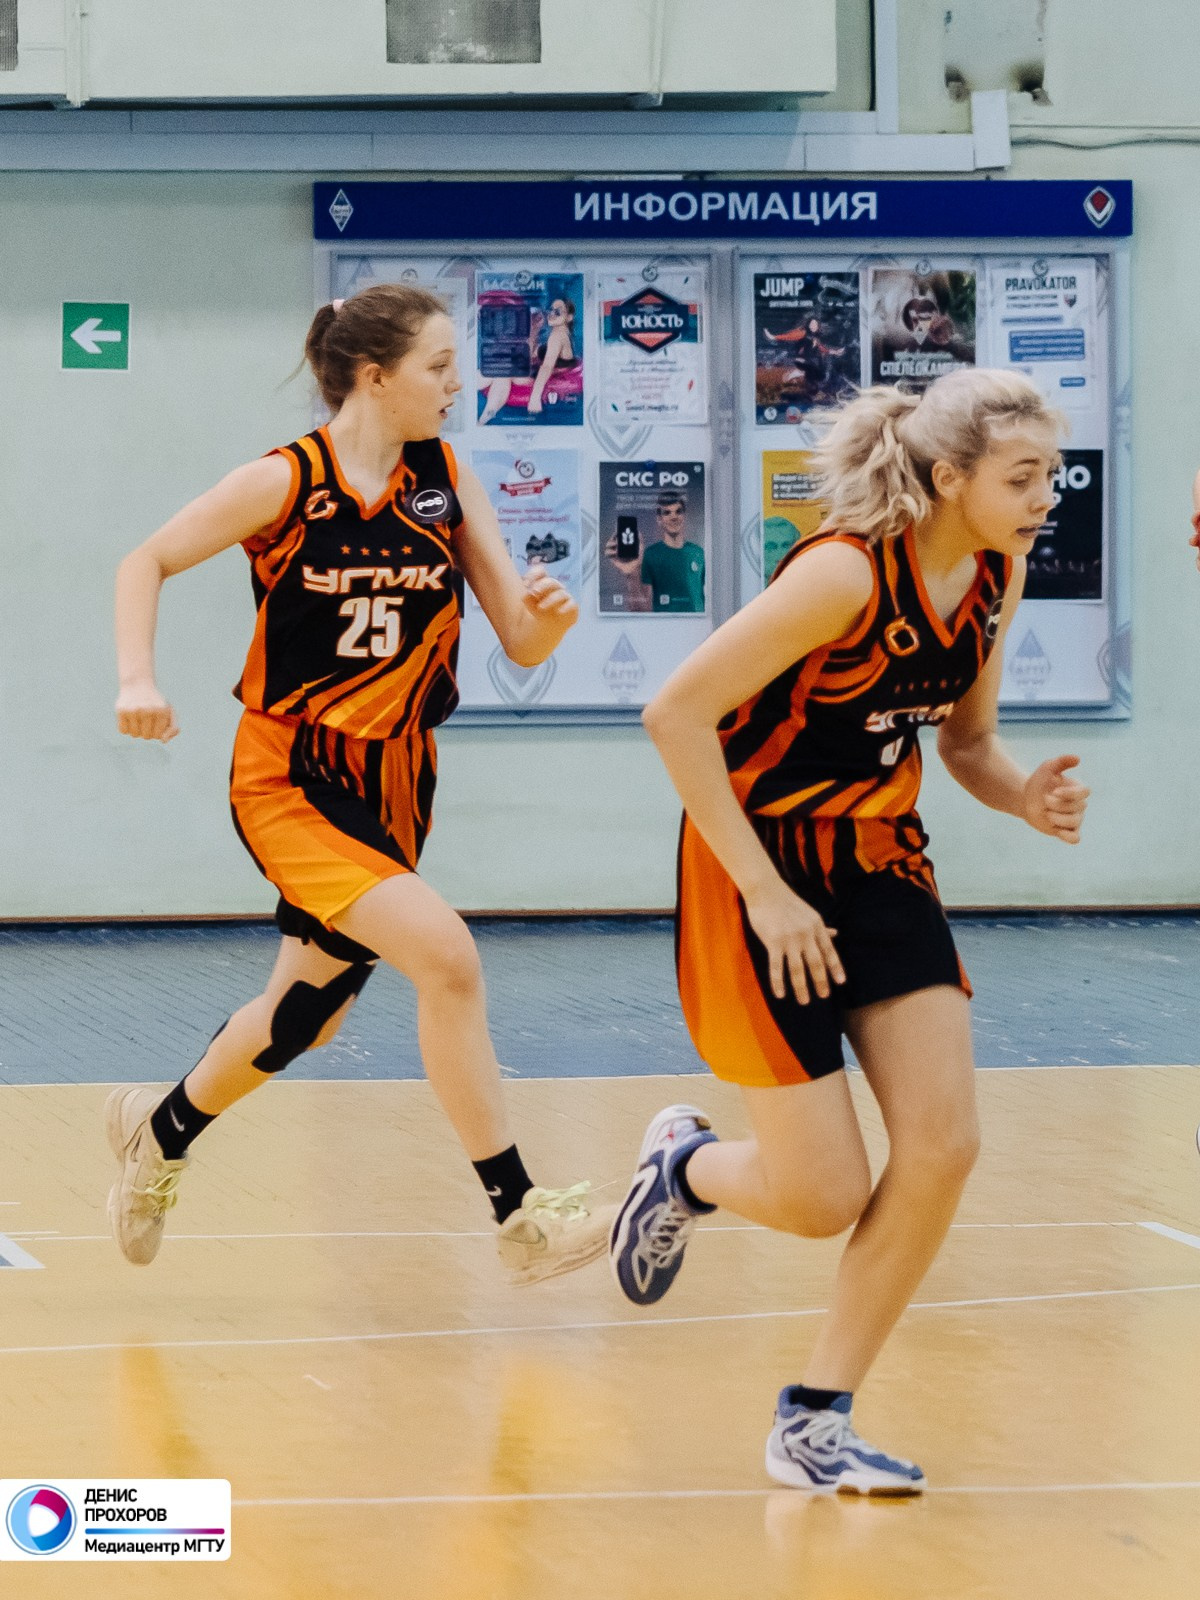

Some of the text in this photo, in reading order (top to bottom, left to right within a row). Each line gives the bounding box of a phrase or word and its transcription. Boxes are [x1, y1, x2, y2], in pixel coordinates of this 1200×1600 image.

[574, 191, 877, 226] ИНФОРМАЦИЯ
[760, 278, 805, 297] JUMP
[1005, 277, 1077, 290] PRAVOKATOR
[621, 314, 684, 328] ЮНОСТЬ
[615, 471, 689, 487] СКС РФ
[302, 563, 450, 596] УГМК
[336, 595, 404, 658] 25
